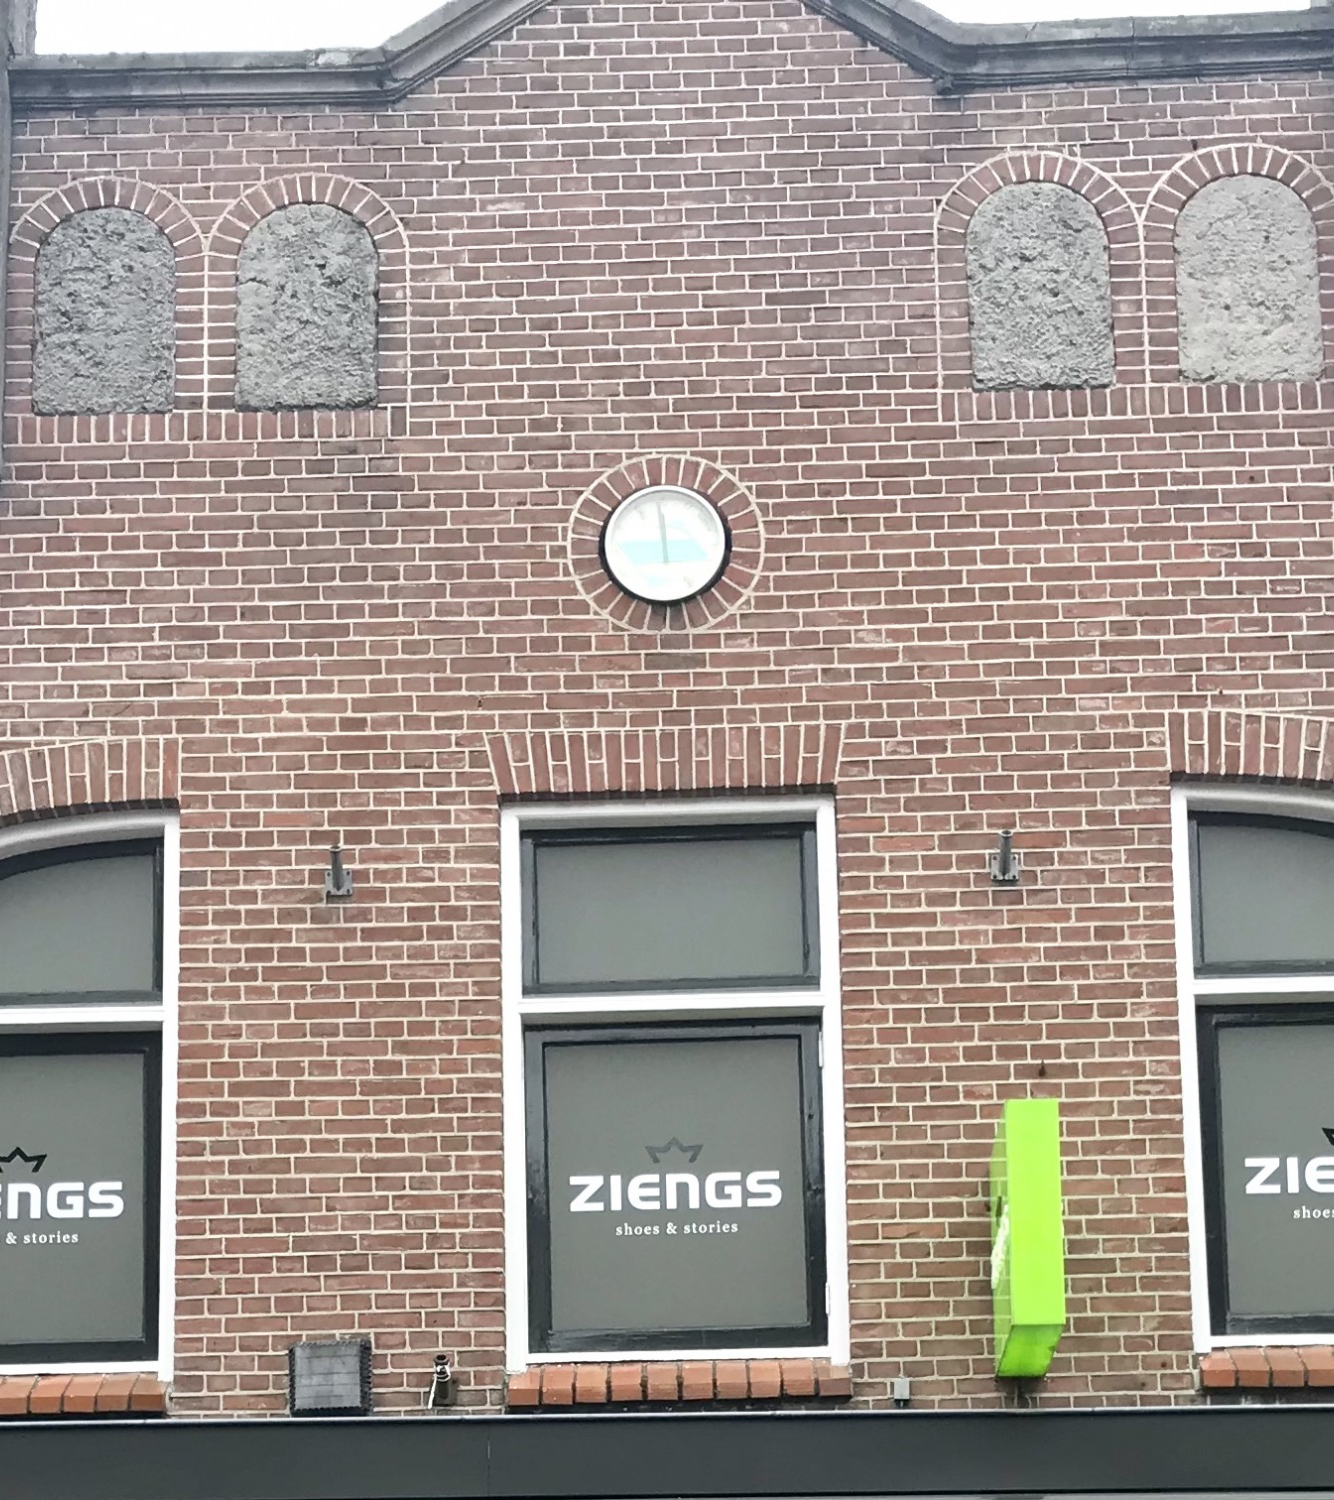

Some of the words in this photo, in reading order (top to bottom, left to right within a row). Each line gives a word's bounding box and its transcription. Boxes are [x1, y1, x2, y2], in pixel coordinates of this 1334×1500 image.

[569, 1170, 782, 1212] ZIENGS
[616, 1222, 660, 1235] shoes
[666, 1222, 678, 1234] &
[683, 1221, 739, 1234] stories
[5, 1231, 17, 1245] &
[23, 1230, 79, 1244] stories
